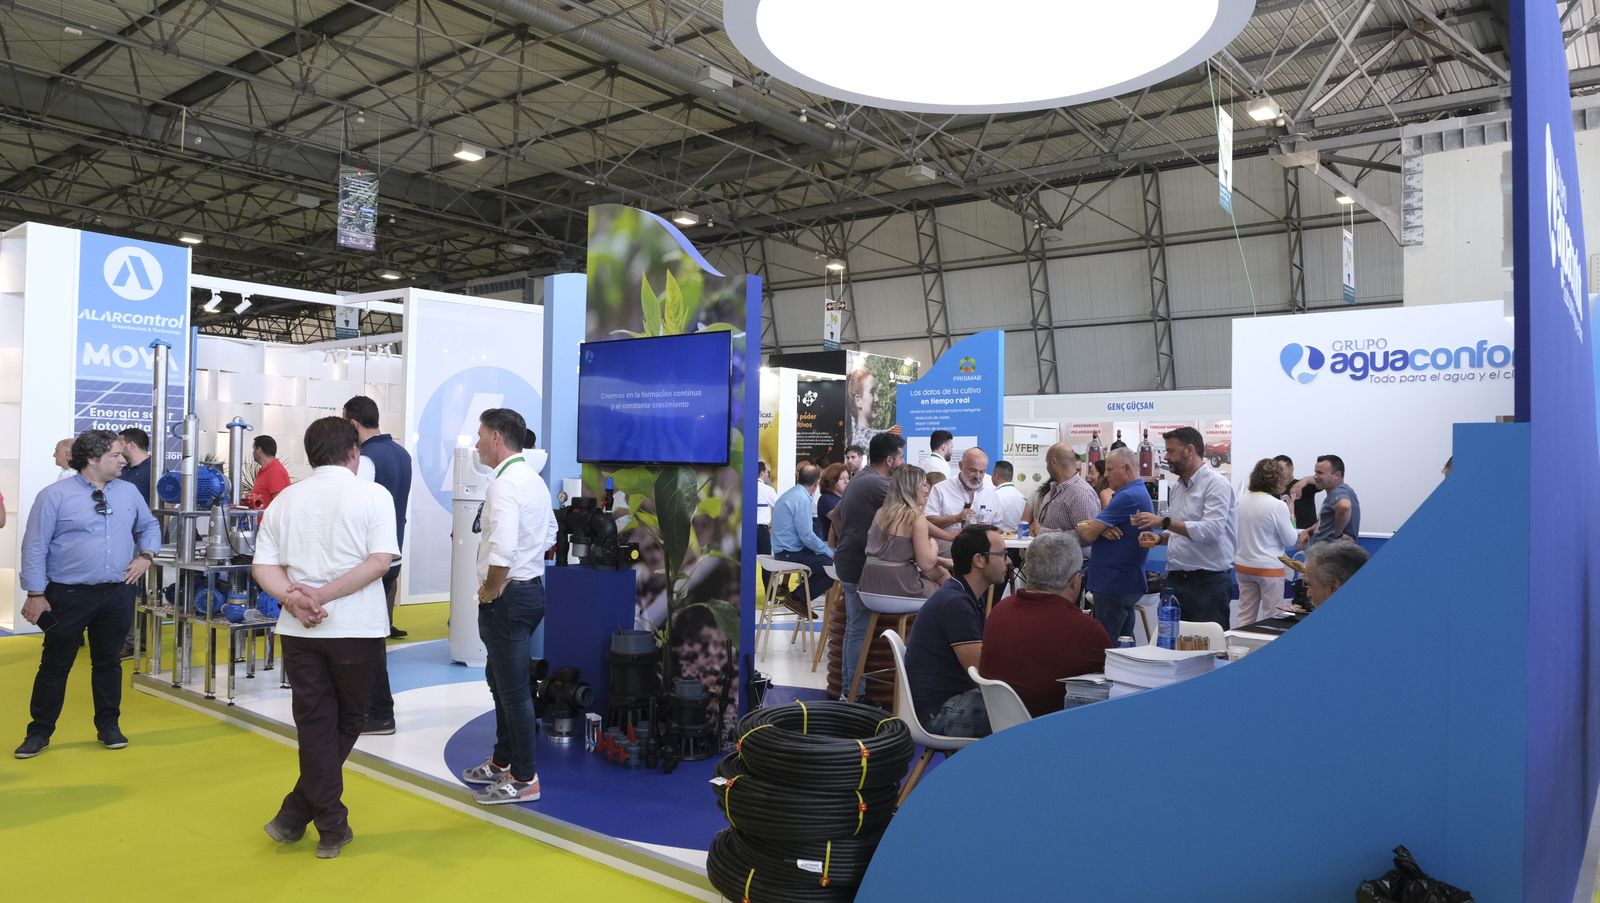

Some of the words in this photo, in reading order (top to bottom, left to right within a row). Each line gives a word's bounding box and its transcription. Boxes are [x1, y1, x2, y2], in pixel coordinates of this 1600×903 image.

[1332, 338, 1388, 351] GRUPO
[1330, 339, 1514, 381] aguaconfo
[1369, 374, 1396, 384] Todo
[1399, 373, 1427, 384] para
[1430, 371, 1441, 381] el
[1443, 372, 1475, 384] agua
[1478, 372, 1486, 382] y
[1489, 370, 1501, 379] el
[960, 386, 982, 394] cultivo
[652, 400, 689, 409] crecimiento
[930, 397, 954, 406] tiempo
[1107, 402, 1126, 413] GENÇ
[1126, 401, 1154, 413] GÜÇSAN
[90, 406, 140, 420] Energía
